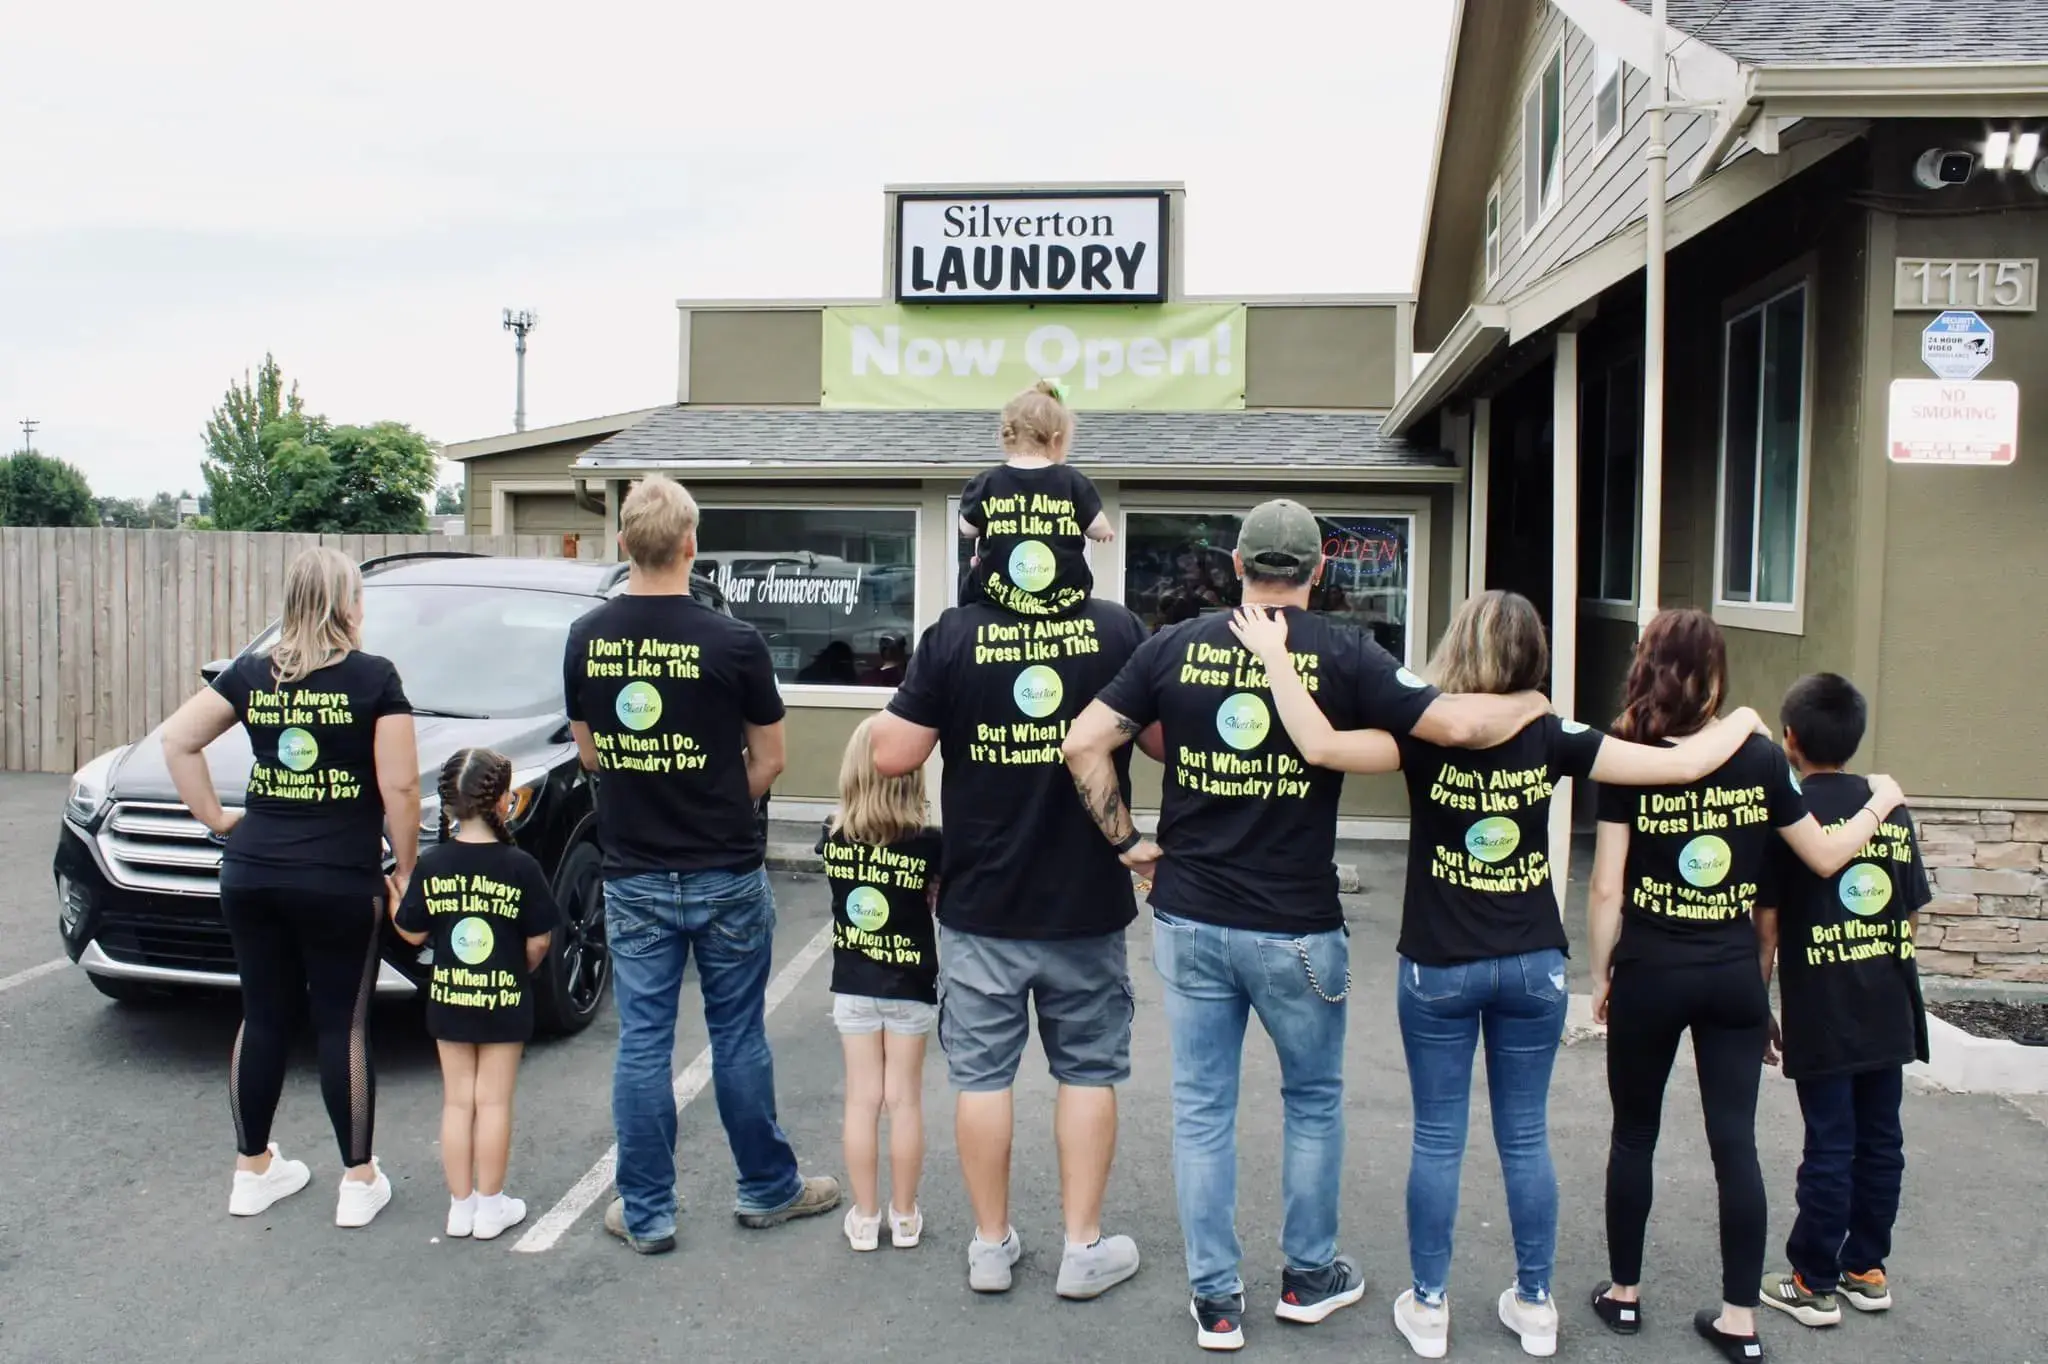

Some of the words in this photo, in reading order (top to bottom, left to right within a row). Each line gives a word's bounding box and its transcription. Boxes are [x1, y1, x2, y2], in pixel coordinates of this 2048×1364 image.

[944, 204, 1114, 238] Silverton
[912, 241, 1146, 293] LAUNDRY
[1914, 262, 2023, 306] 1115
[1940, 336, 1963, 344] HOUR
[851, 324, 1006, 377] Now
[1024, 324, 1231, 389] Open!
[1941, 388, 1966, 401] NO
[1911, 404, 1997, 420] SMOKING
[986, 520, 1017, 539] ress
[1021, 515, 1053, 535] Like
[1322, 538, 1399, 561] OPEN
[718, 564, 755, 603] Year
[758, 564, 862, 615] Anniversary!
[978, 625, 983, 643] I
[988, 622, 1031, 642] Don't
[1034, 618, 1095, 639] Always
[589, 639, 594, 657] I
[596, 638, 634, 657] Don't
[639, 638, 700, 661] Always
[975, 645, 1021, 664] Dress
[1025, 641, 1059, 660] Like
[1063, 635, 1100, 656] This
[1186, 642, 1195, 662] I
[1197, 643, 1246, 666] Don't
[587, 659, 623, 678] Dress
[627, 658, 661, 677] Like
[666, 659, 700, 679] This
[1180, 664, 1229, 686] Dress
[1235, 667, 1270, 688] Like
[249, 690, 254, 706] I
[255, 689, 289, 707] Don't
[293, 689, 349, 708] Always
[247, 708, 280, 724] Dress
[284, 708, 313, 724] Like
[318, 707, 353, 724] This
[618, 733, 660, 752] When
[663, 734, 669, 751] I
[672, 733, 700, 751] Do,
[977, 723, 1007, 742] But
[1012, 724, 1057, 743] When
[1060, 720, 1066, 739] I
[611, 752, 672, 773] Laundry
[676, 753, 707, 770] Day
[970, 744, 996, 763] It's
[1001, 744, 1065, 765] Laundry
[1179, 746, 1207, 769] But
[1211, 751, 1262, 774] When
[1267, 754, 1273, 773] I
[1278, 755, 1304, 774] Do,
[253, 762, 271, 781] But
[274, 768, 315, 785] When
[318, 769, 325, 784] I
[328, 768, 355, 784] Do,
[1177, 766, 1198, 789] It's
[1202, 773, 1272, 800] Laundry
[1278, 778, 1311, 799] Day
[1438, 763, 1448, 783] I
[1446, 766, 1484, 790] Don't
[265, 781, 326, 802] Laundry
[331, 784, 361, 800] Day
[1430, 783, 1477, 810] Dress
[1481, 792, 1519, 812] Like
[1640, 795, 1646, 814] I
[1652, 790, 1698, 813] Don't
[1702, 785, 1765, 807] Always
[1638, 816, 1688, 834] Dress
[1692, 811, 1728, 831] Like
[1732, 805, 1768, 826] This
[829, 842, 865, 861] Don't
[870, 846, 926, 874] Always
[1436, 845, 1463, 868] But
[1468, 855, 1516, 876] When
[1519, 857, 1526, 874] I
[858, 864, 889, 884] Like
[894, 871, 924, 889] This
[1432, 859, 1458, 885] It's
[1459, 870, 1529, 892] Laundry
[424, 879, 430, 896] I
[431, 874, 467, 895] Don't
[470, 874, 522, 902] Always
[1642, 876, 1673, 896] But
[1677, 887, 1728, 905] When
[1730, 885, 1735, 903] I
[462, 894, 489, 912] Like
[491, 898, 520, 919] This
[1633, 887, 1660, 913] It's
[1666, 898, 1738, 920] Laundry
[845, 926, 883, 947] When
[885, 935, 891, 948] I
[1812, 925, 1841, 944] But
[1844, 919, 1888, 939] When
[896, 948, 921, 965] Day
[1806, 946, 1835, 965] It's
[451, 967, 488, 987] When
[491, 970, 496, 987] I
[498, 970, 517, 988] Do,
[443, 986, 497, 1010] Laundry
[500, 989, 522, 1007] Day
